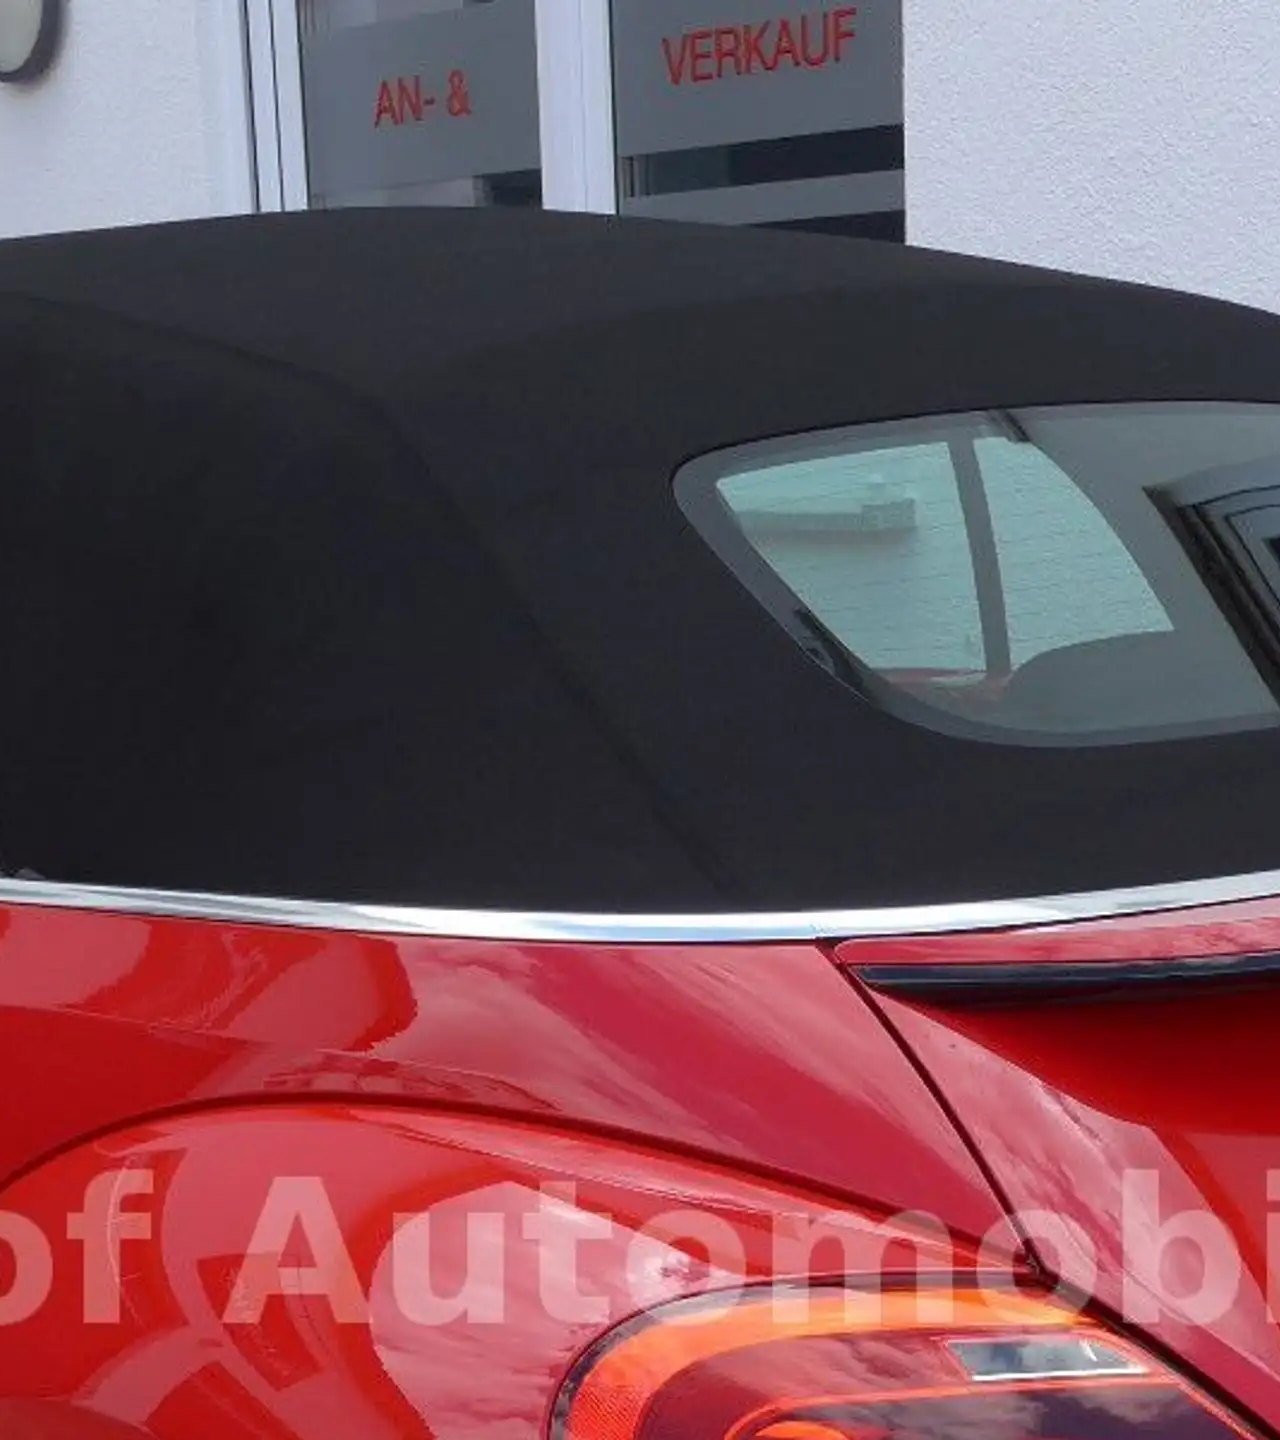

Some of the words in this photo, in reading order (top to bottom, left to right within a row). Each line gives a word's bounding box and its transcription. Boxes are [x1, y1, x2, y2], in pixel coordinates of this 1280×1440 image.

[374, 74, 435, 128] AN-
[447, 69, 472, 117] &
[661, 8, 858, 86] VERKAUF
